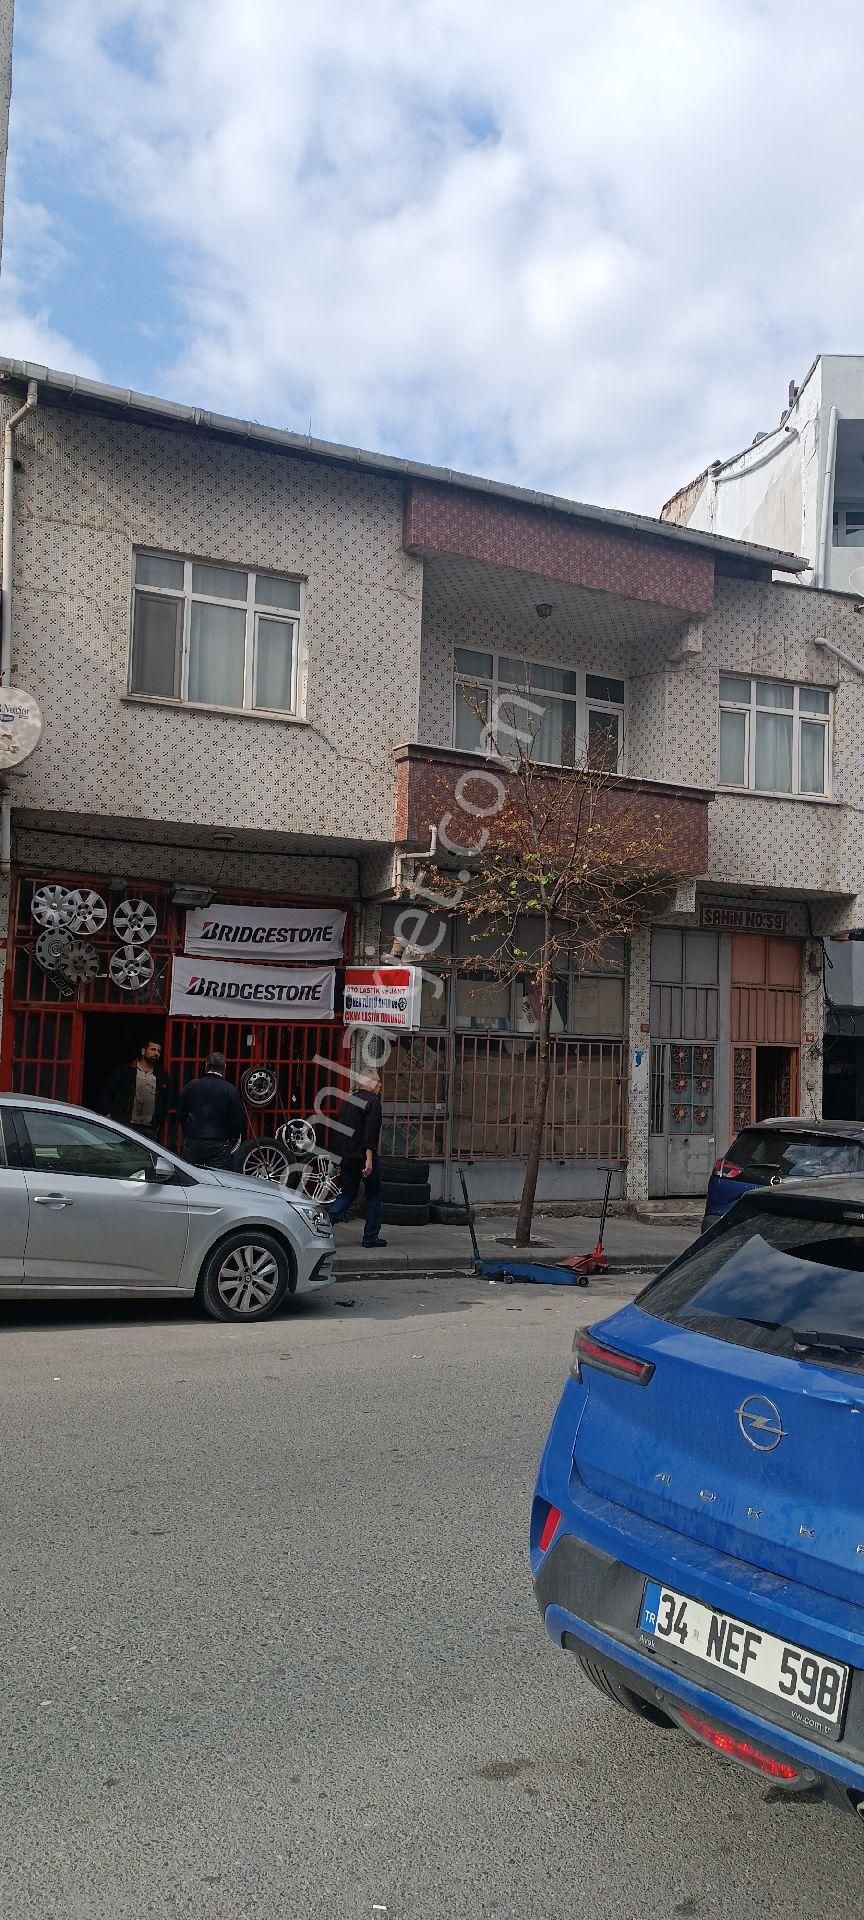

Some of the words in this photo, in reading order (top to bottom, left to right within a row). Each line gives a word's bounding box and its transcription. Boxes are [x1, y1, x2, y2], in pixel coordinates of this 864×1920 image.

[200, 921, 334, 944] BRIDGESTONE
[185, 976, 323, 1001] BRIDGESTONE
[644, 1609, 656, 1626] TR
[657, 1593, 689, 1645] 34
[706, 1614, 763, 1675] NEF
[778, 1647, 841, 1716] 598
